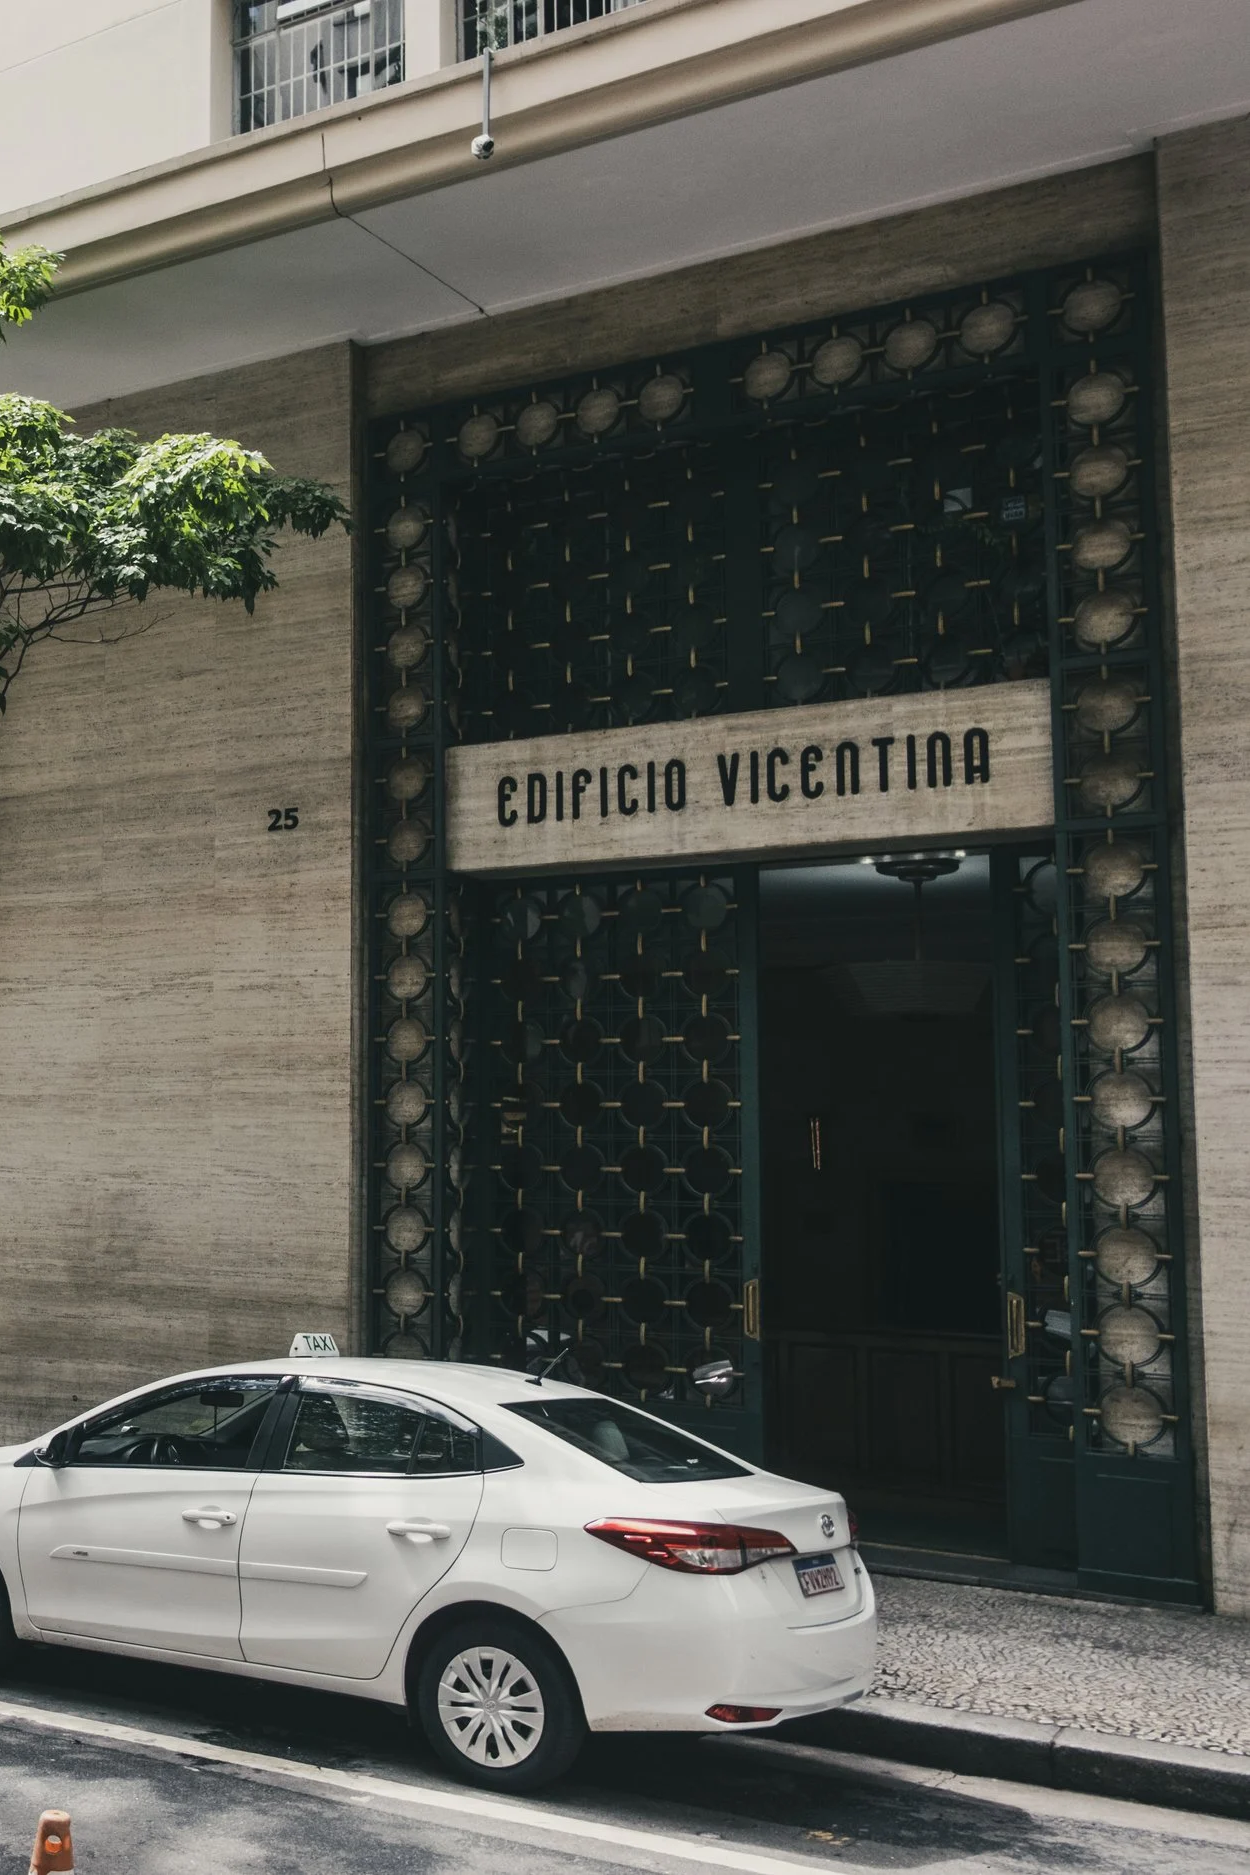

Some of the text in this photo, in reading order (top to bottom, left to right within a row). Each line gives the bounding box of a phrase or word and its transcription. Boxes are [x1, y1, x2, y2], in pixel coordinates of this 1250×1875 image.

[497, 727, 990, 827] EDIFICIO VICENTINA
[267, 807, 299, 832] 25
[302, 1335, 336, 1351] TAXI
